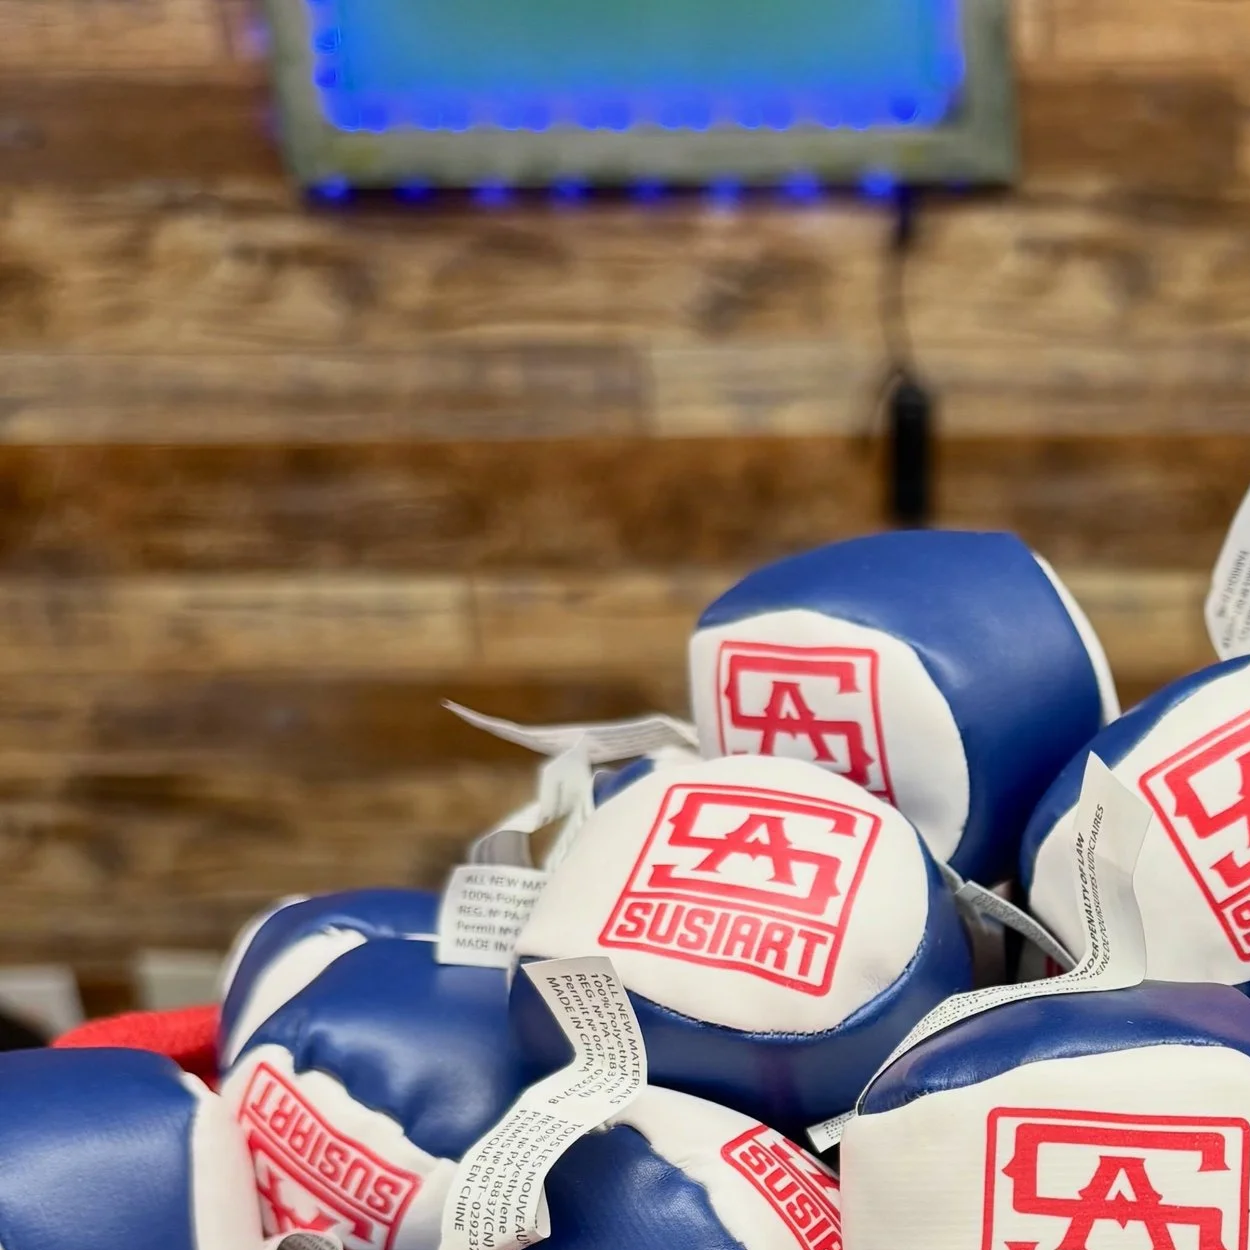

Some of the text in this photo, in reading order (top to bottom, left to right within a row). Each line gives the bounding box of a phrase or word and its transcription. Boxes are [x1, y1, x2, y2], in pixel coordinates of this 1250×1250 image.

[1076, 832, 1085, 866] LAW
[1088, 804, 1104, 876] JUDICIAIRES
[1079, 865, 1088, 884] OF
[1082, 884, 1098, 942] PENALTY
[456, 938, 488, 950] MADE
[614, 901, 829, 978] SUSIART
[560, 974, 590, 1016] Permit
[576, 973, 596, 1002] REG.
[546, 976, 595, 1073] MADE IN CHINA
[590, 972, 629, 1094] 100% Polyethylene
[602, 973, 640, 1105] ALL NEW MATERIALS
[500, 1111, 541, 1148] PERMIS
[528, 1114, 555, 1136] REG.
[550, 1123, 584, 1148] TOUS
[250, 1079, 402, 1214] SUSIART
[532, 1148, 554, 1168] LES
[466, 1164, 482, 1183] EN
[498, 1118, 568, 1234] 100% Polyethylene
[454, 1185, 472, 1231] CHINE
